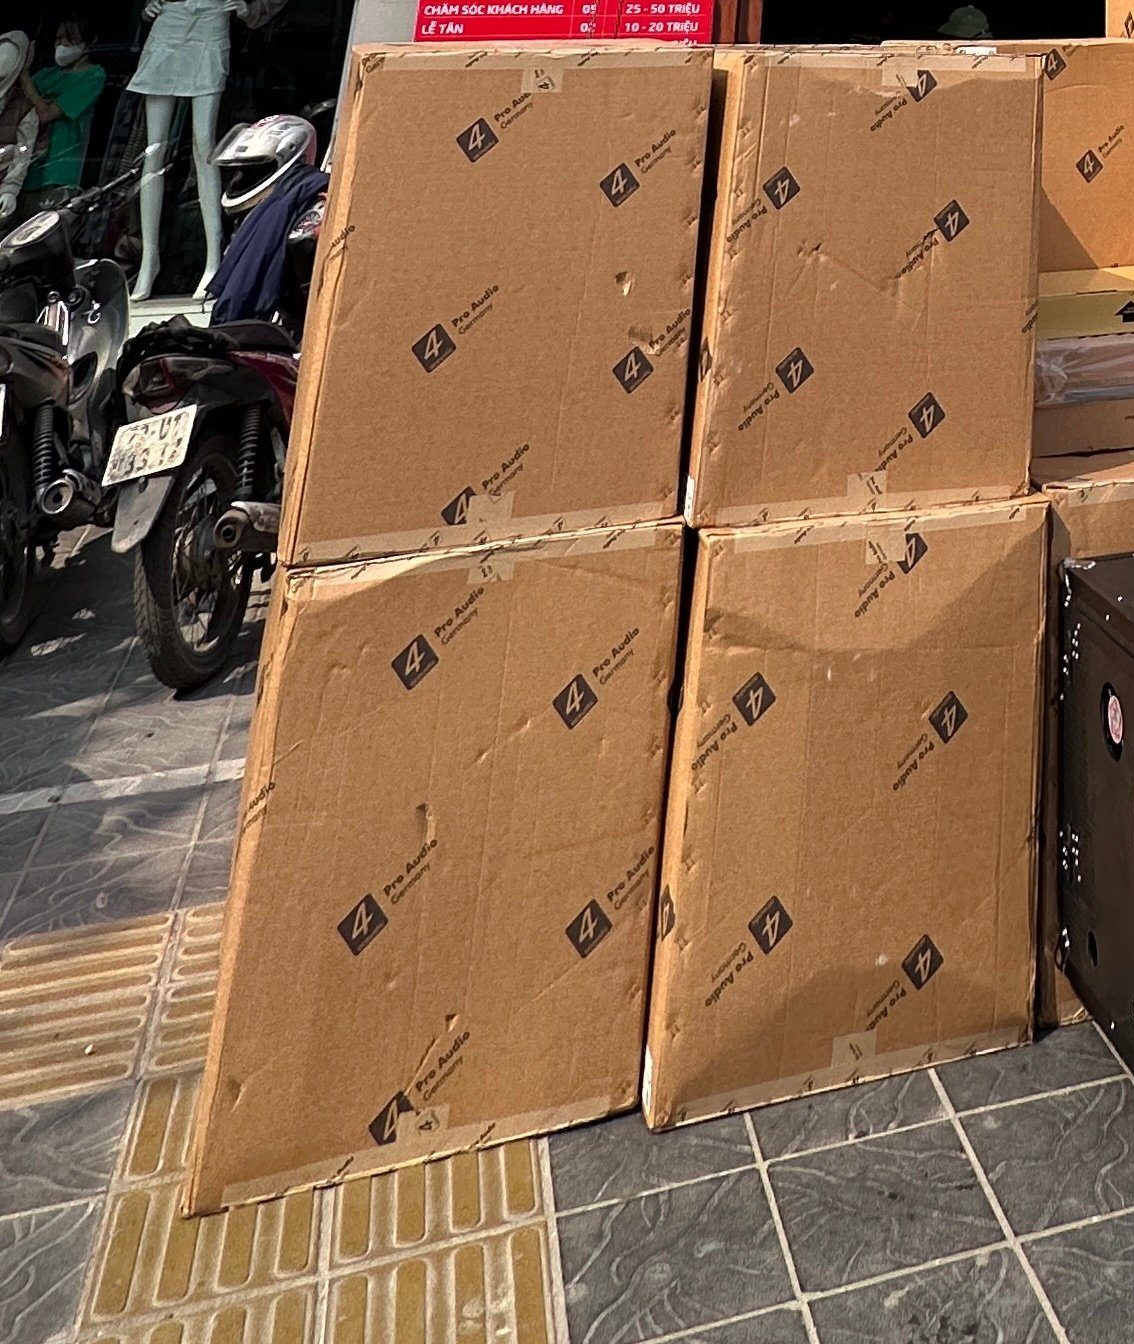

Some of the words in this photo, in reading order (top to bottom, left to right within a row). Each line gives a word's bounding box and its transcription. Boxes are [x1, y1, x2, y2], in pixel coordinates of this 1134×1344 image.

[487, 3, 528, 15] KHÁCH
[626, 4, 641, 14] 25
[650, 4, 665, 14] 50
[668, 2, 700, 16] TRIỆU
[625, 22, 640, 32] 10
[649, 22, 664, 32] 20
[666, 20, 699, 33] TRIỆU
[494, 106, 511, 123] Pro
[634, 151, 652, 168] Pro
[651, 129, 677, 153] Audio
[451, 311, 471, 328] Pro
[471, 285, 499, 312] Audio
[648, 333, 666, 349] Pro
[666, 308, 692, 333] Audio
[764, 389, 781, 406] Pro
[737, 405, 764, 431] Audio
[898, 433, 914, 451] Pro
[482, 473, 500, 490] Pro
[501, 443, 530, 472] Audio
[434, 617, 453, 638] Pro
[454, 587, 485, 617] Audio
[592, 658, 611, 678] Pro
[611, 627, 640, 659] Audio
[720, 722, 738, 741] Pro
[691, 741, 720, 771] Audio
[918, 741, 935, 760] Pro
[892, 759, 919, 791] Audio
[383, 874, 404, 897] Pro
[406, 838, 438, 874] Audio
[607, 882, 625, 902] Pro
[626, 845, 655, 880] Audio
[735, 951, 754, 972] Pro
[705, 972, 735, 1007] Audio
[415, 1069, 436, 1092] Pro
[438, 1030, 471, 1067] Audio
